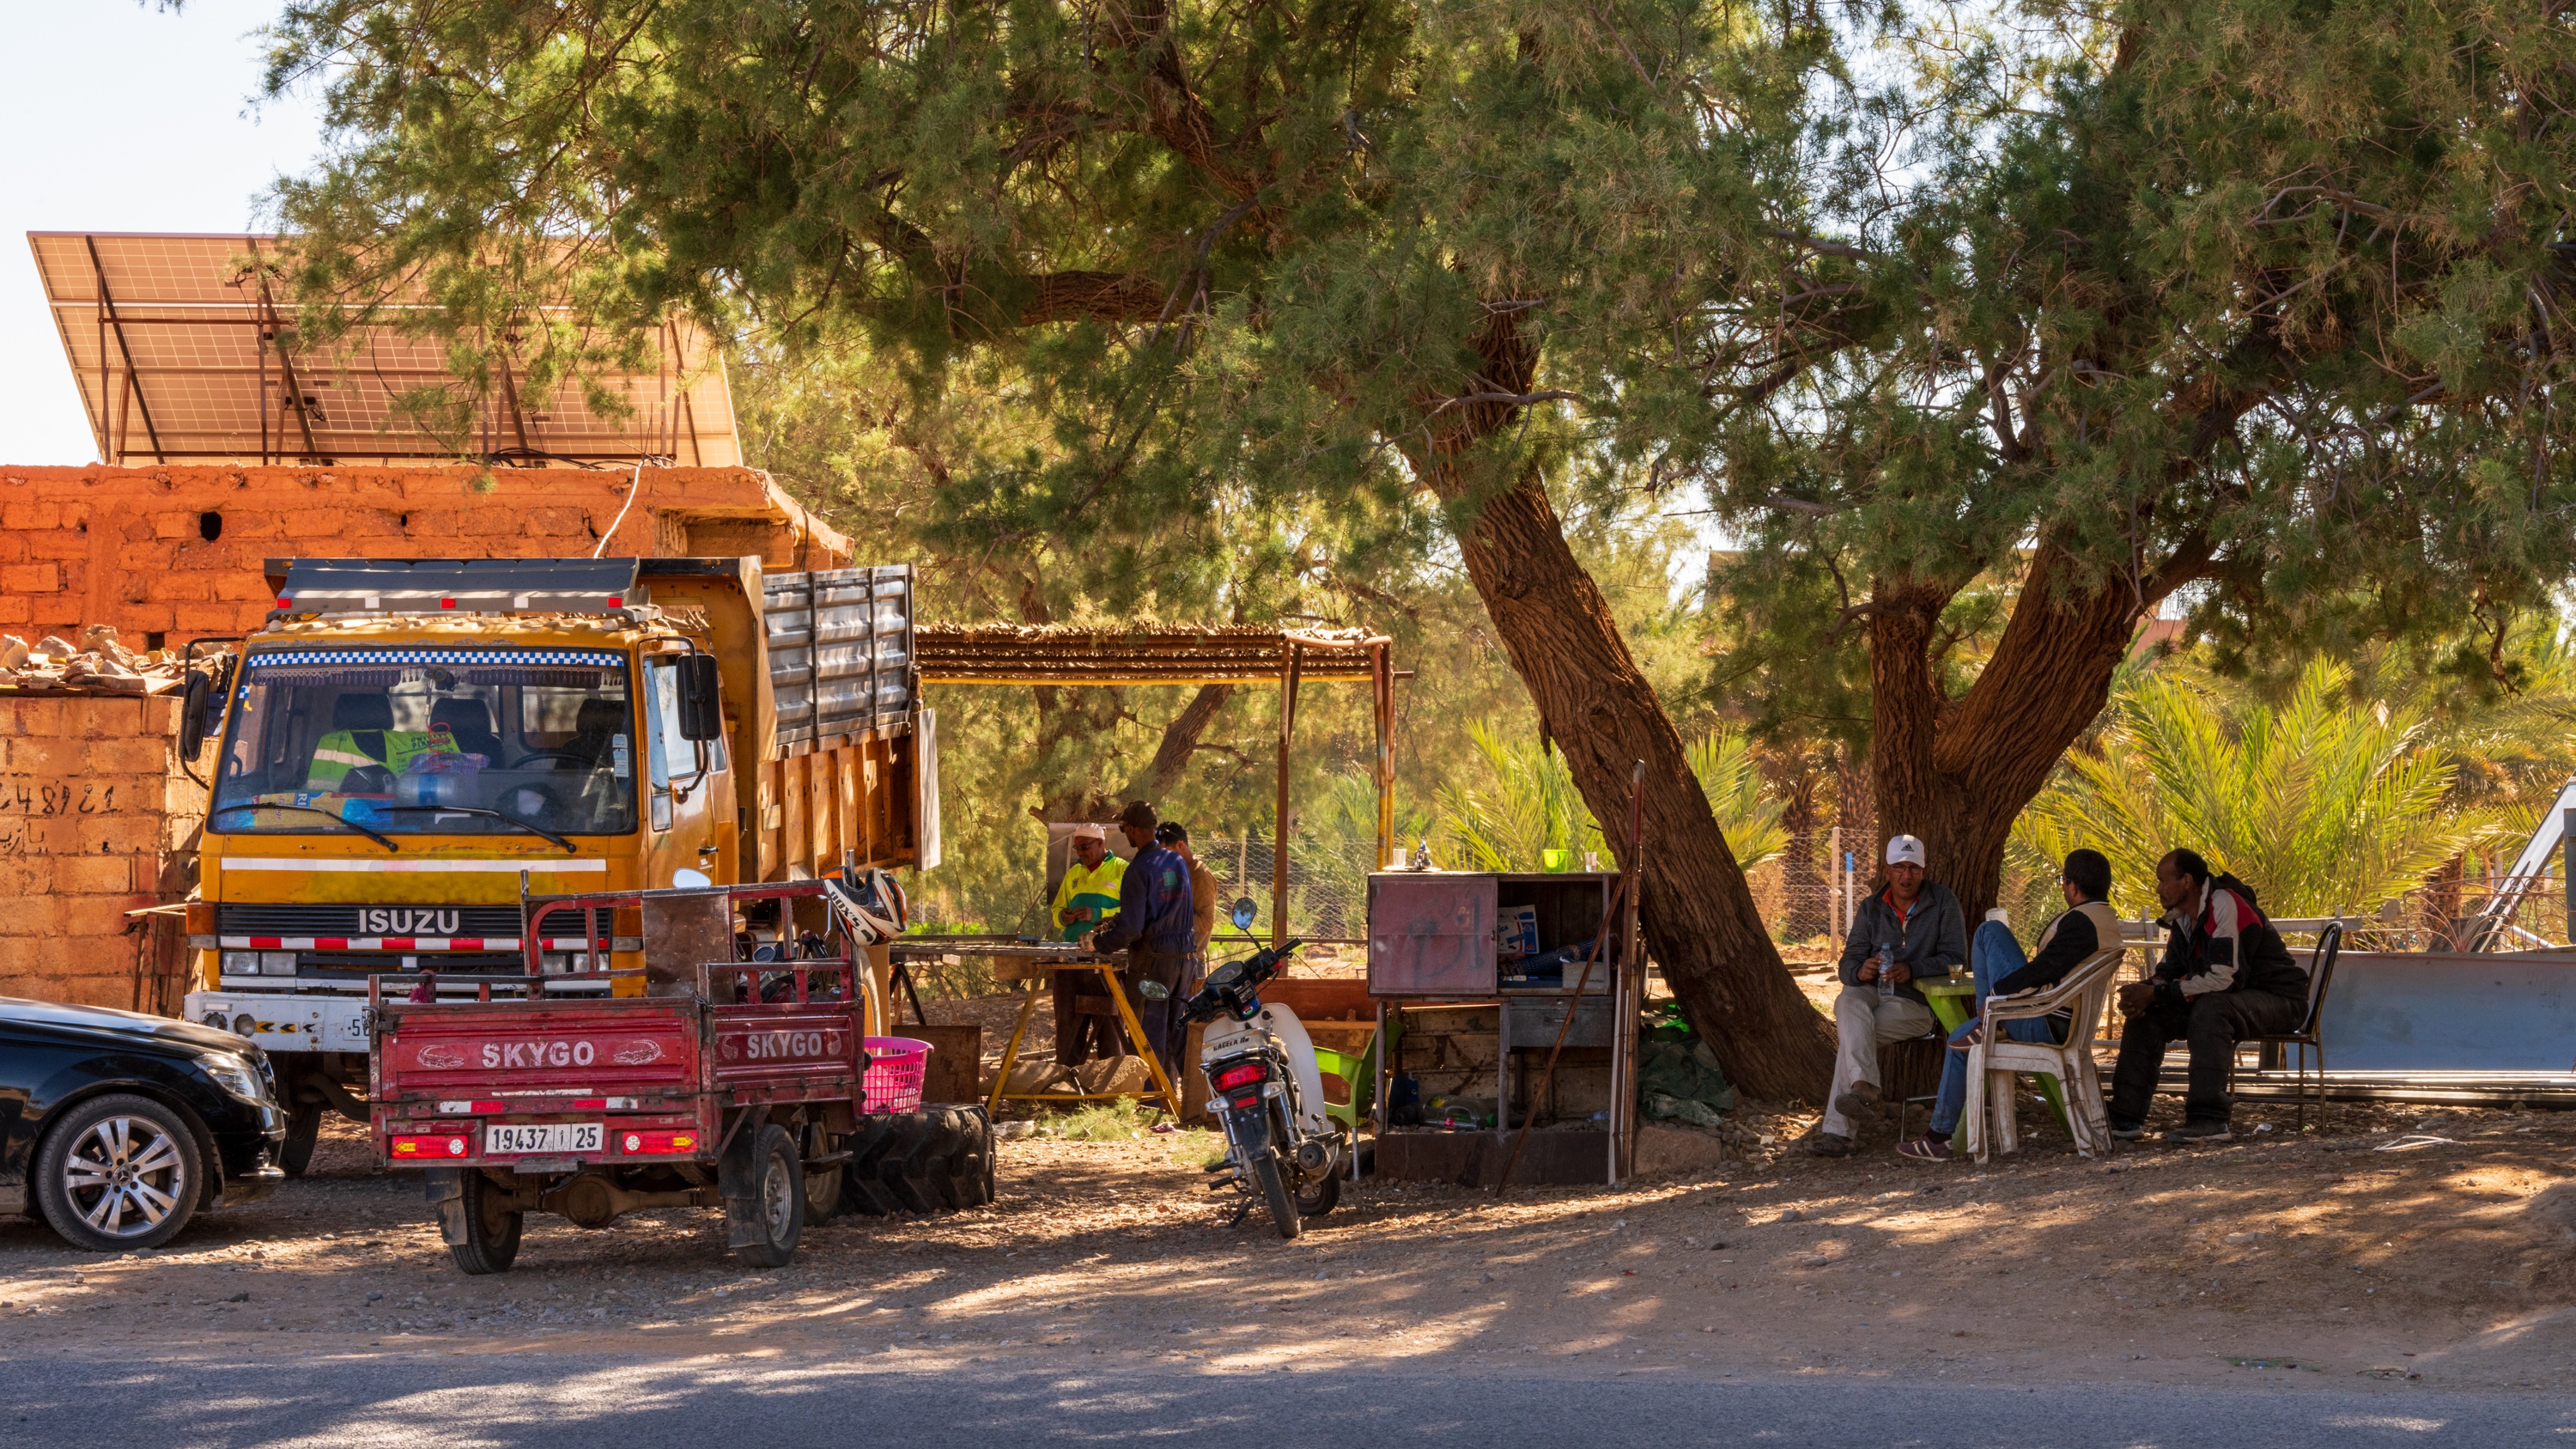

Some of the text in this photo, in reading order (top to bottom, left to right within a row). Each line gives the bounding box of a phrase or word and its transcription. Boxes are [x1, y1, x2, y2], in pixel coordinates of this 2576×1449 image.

[359, 910, 459, 934] ISUZU
[482, 1041, 594, 1068] SKYGO
[747, 1032, 823, 1059] SKYGO
[494, 1129, 548, 1149] 19437
[576, 1127, 597, 1148] 25
